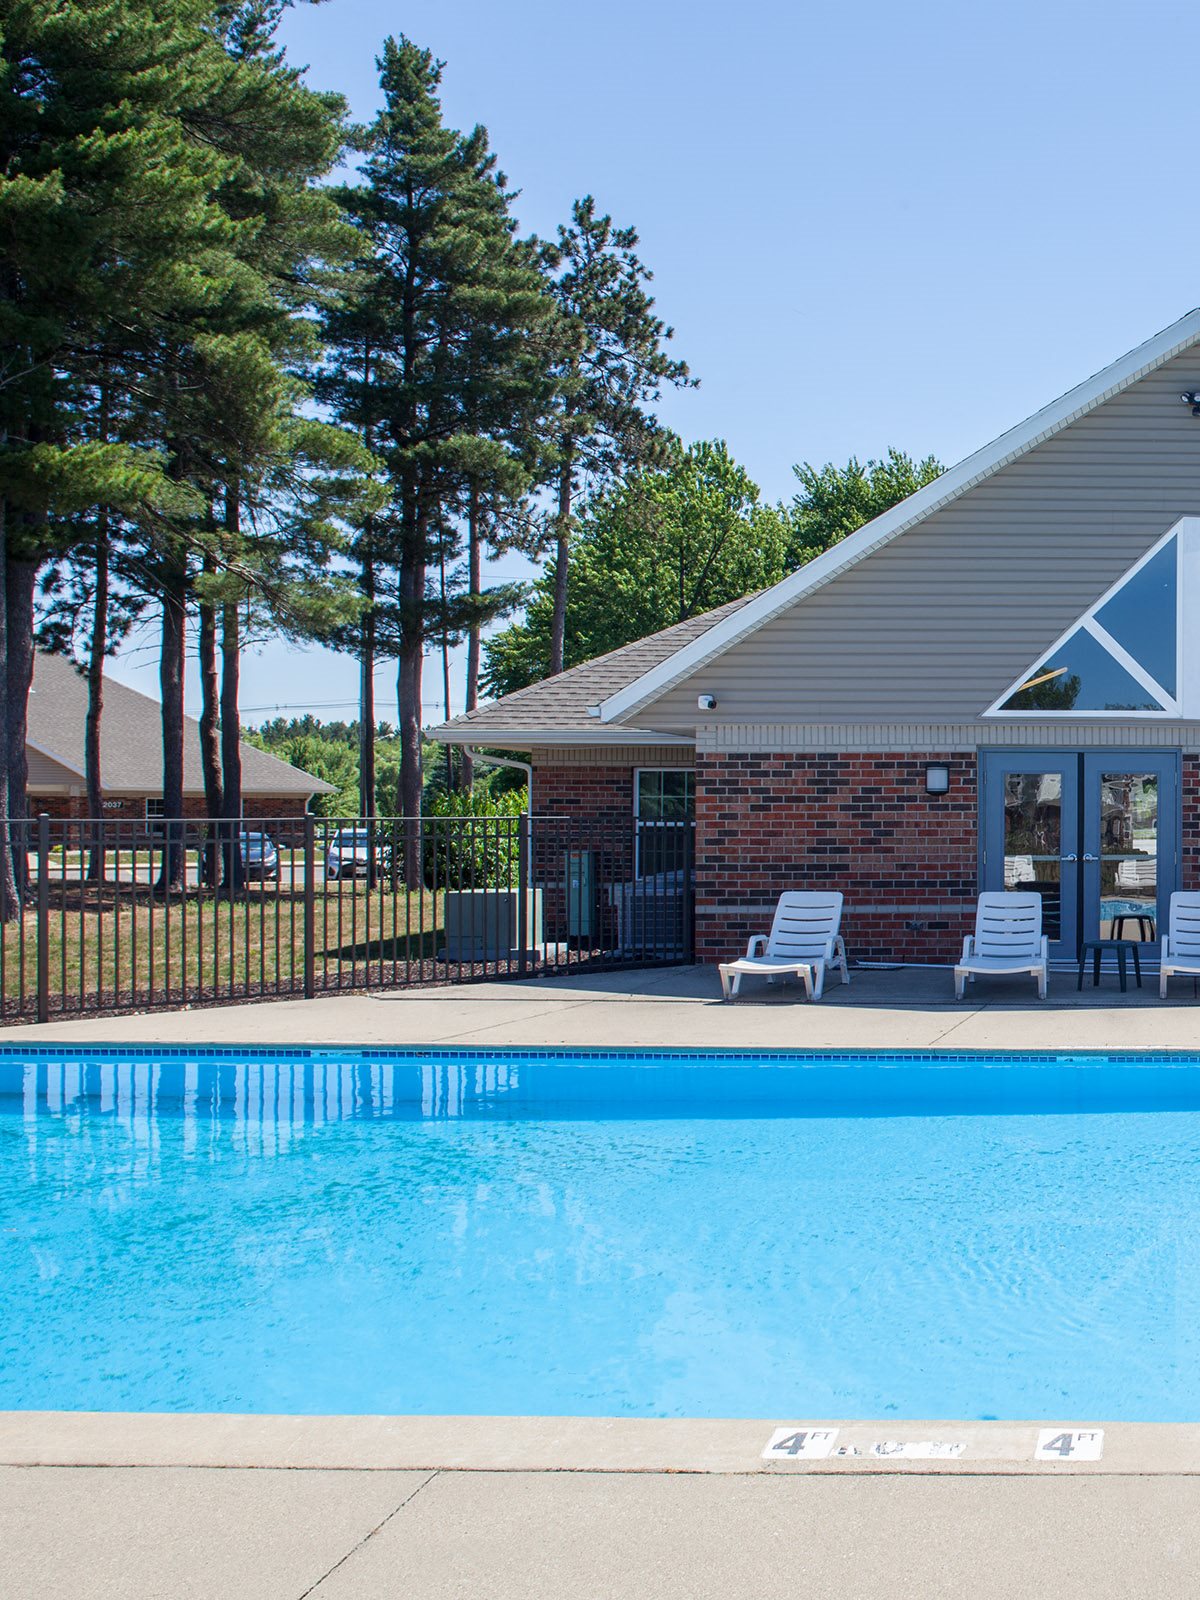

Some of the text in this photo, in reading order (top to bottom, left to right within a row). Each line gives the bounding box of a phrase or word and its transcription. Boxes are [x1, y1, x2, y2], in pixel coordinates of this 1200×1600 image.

[772, 1432, 833, 1455] 4 FT
[1042, 1433, 1098, 1456] 4 FT
